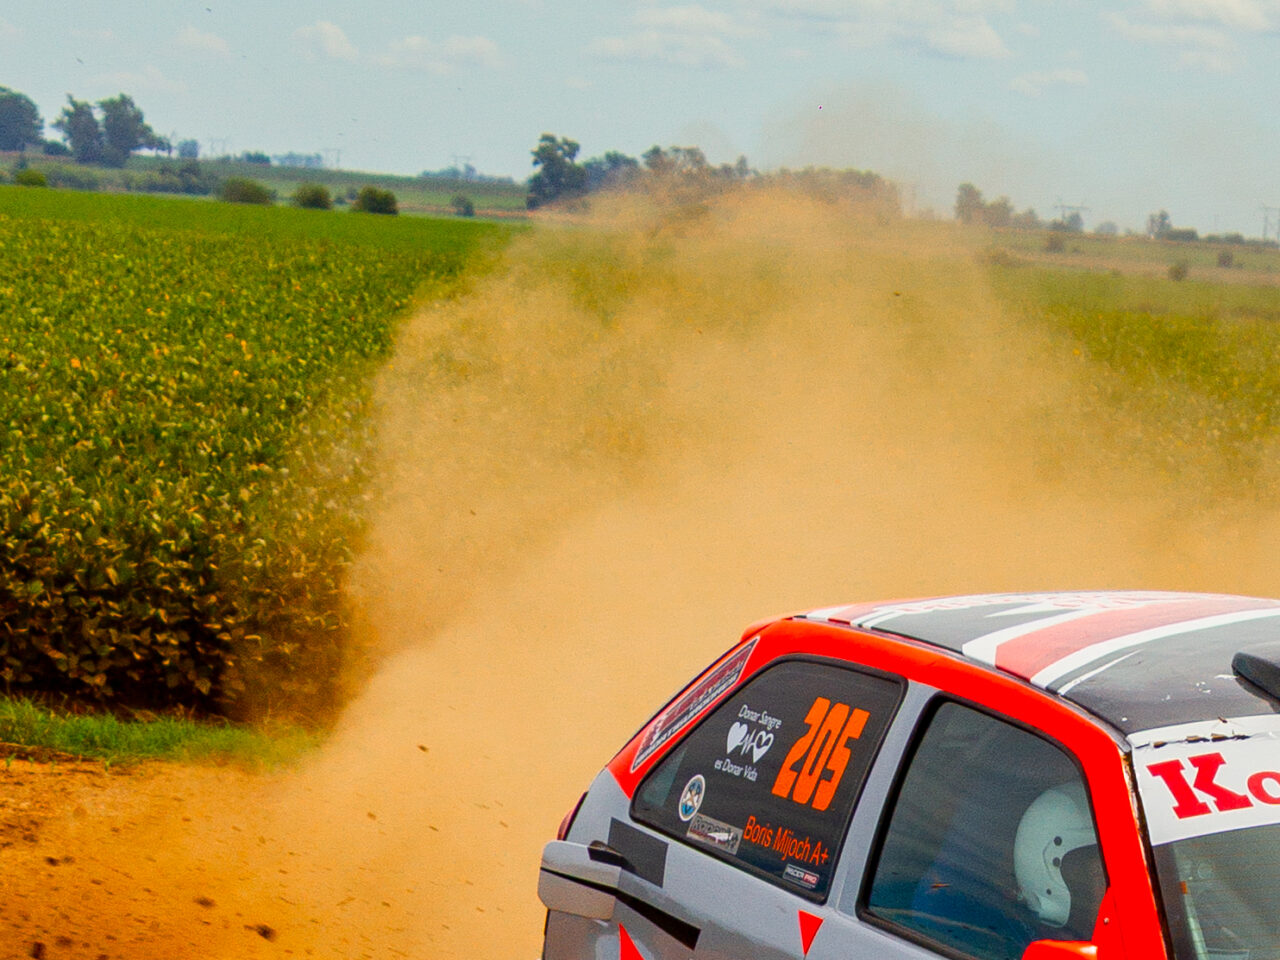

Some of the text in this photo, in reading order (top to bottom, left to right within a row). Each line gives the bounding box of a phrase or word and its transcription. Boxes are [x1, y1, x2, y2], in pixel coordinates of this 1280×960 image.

[738, 704, 783, 731] Donar Sangre
[722, 758, 744, 777] Donar
[743, 764, 759, 783] Vida
[771, 696, 871, 812] 205
[743, 815, 773, 848] Boris
[809, 840, 829, 866] A+
